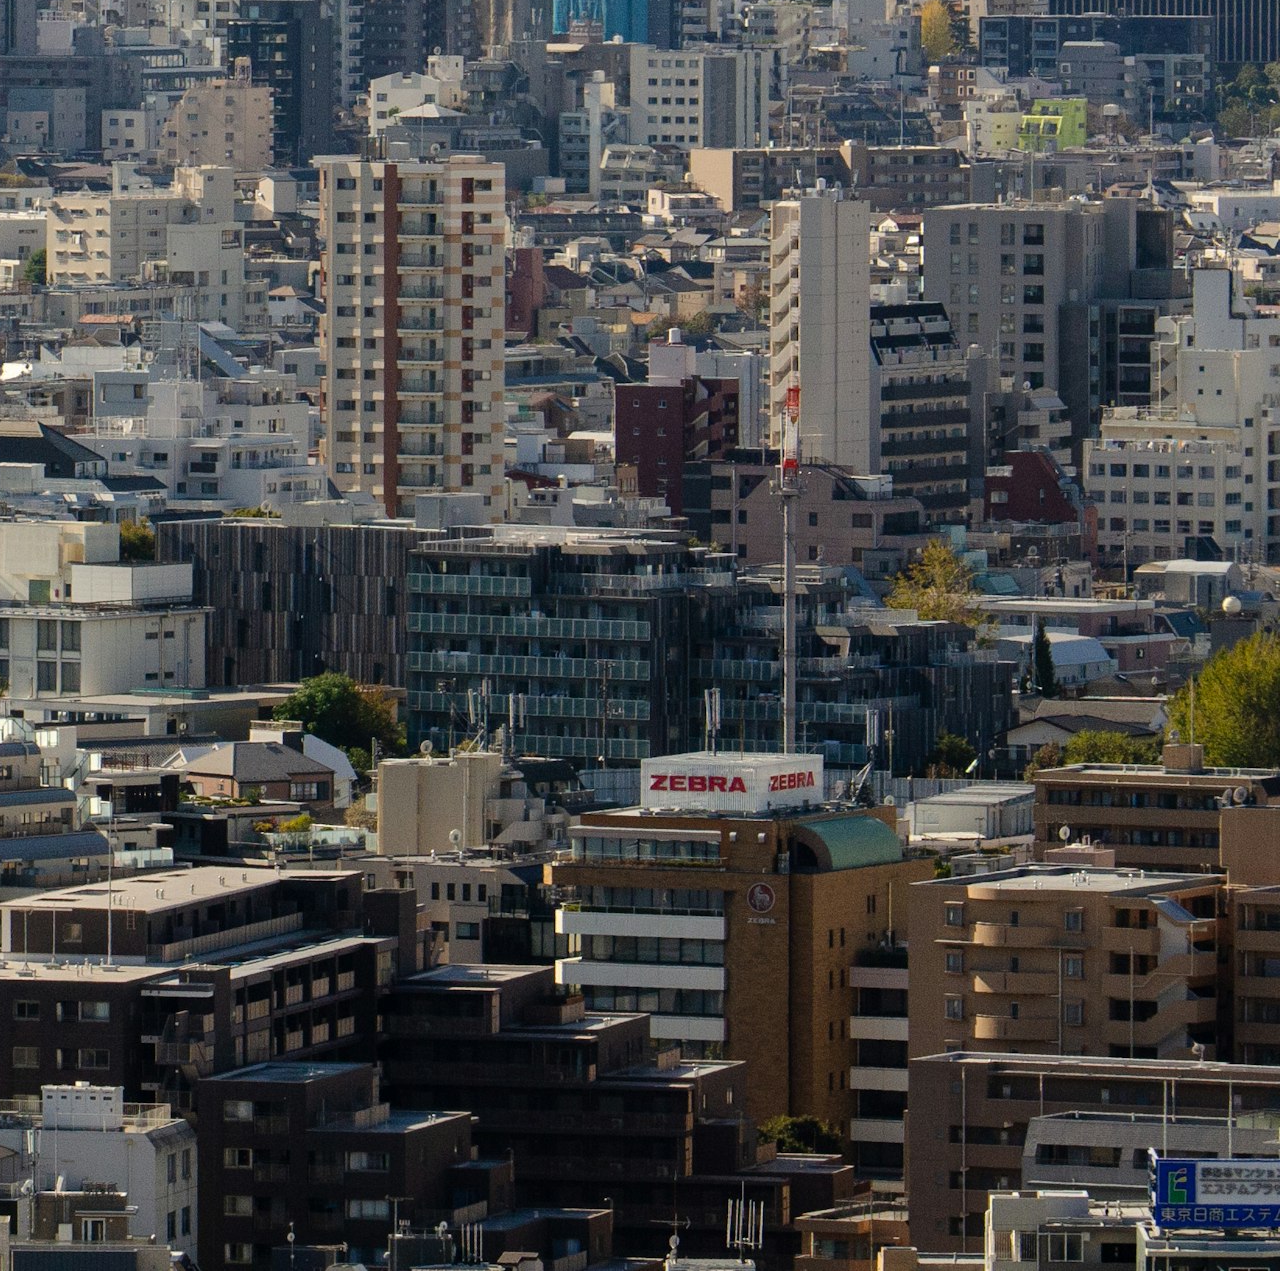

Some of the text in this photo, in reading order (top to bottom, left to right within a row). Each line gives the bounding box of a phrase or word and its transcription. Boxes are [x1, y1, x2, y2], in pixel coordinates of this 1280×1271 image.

[650, 775, 747, 793] ZEBRA
[770, 771, 815, 791] ZEBRA
[747, 917, 776, 925] ZEBRA
